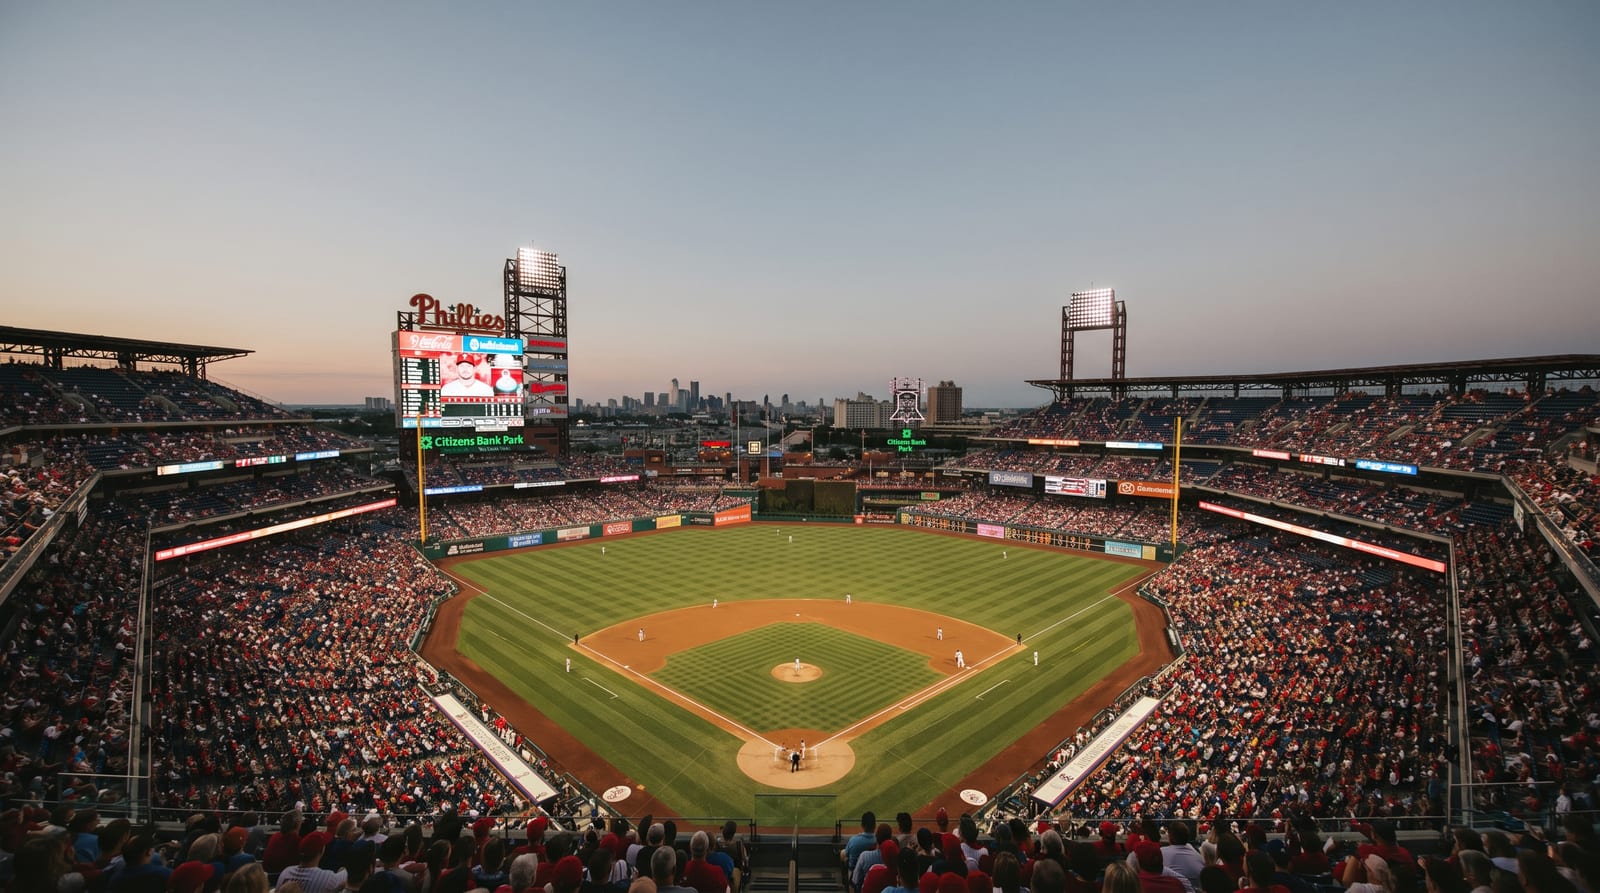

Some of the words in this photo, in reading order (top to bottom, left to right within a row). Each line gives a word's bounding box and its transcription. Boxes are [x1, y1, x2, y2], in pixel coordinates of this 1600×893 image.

[409, 293, 505, 330] Phillies
[435, 436, 475, 447] Citizens
[476, 435, 502, 446] Bank
[503, 434, 524, 445] Park
